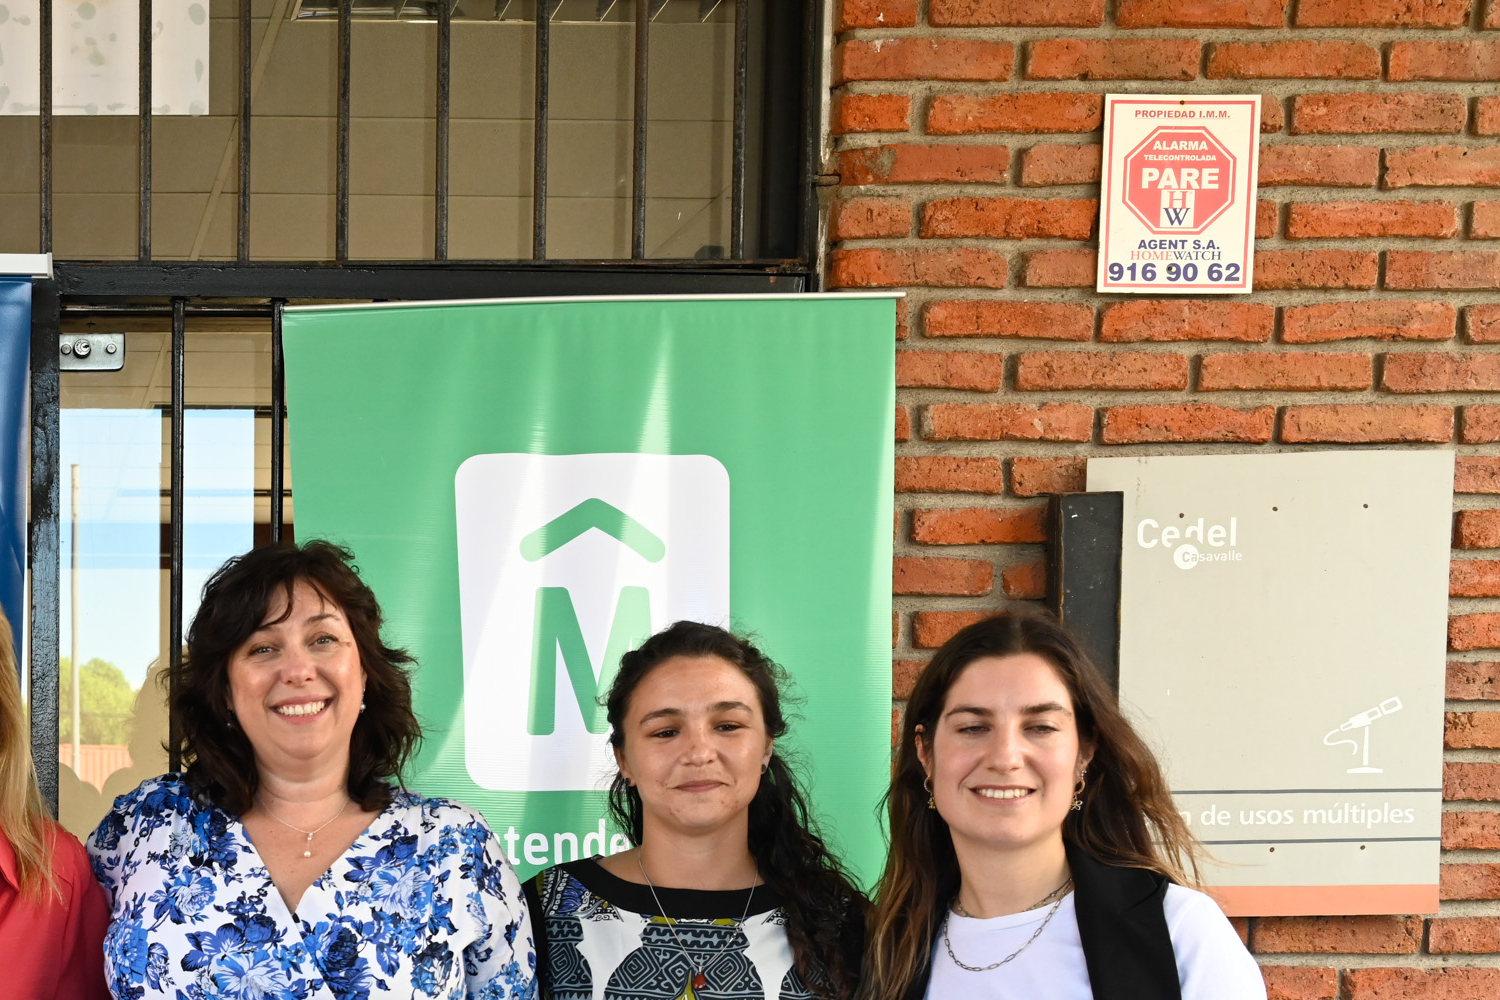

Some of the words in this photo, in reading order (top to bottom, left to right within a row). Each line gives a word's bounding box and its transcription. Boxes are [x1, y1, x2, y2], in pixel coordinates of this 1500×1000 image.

[1135, 110, 1196, 118] PROPIEDAD
[1199, 110, 1231, 118] I.M.M.
[1153, 140, 1208, 151] ALARMA
[1144, 154, 1217, 162] TELECONTROLADA
[1141, 167, 1220, 190] PARE
[1138, 239, 1188, 250] AGENT
[1192, 240, 1221, 250] S.A.
[1130, 250, 1222, 261] HOMEWATCH
[1108, 262, 1157, 282] 916
[1166, 262, 1198, 282] 90
[1207, 262, 1241, 282] 62
[1137, 516, 1237, 549] Cedel
[1181, 549, 1243, 563] Casavalle
[1200, 804, 1231, 826] de
[1239, 807, 1294, 825] usos
[1303, 803, 1415, 829] múltiples
